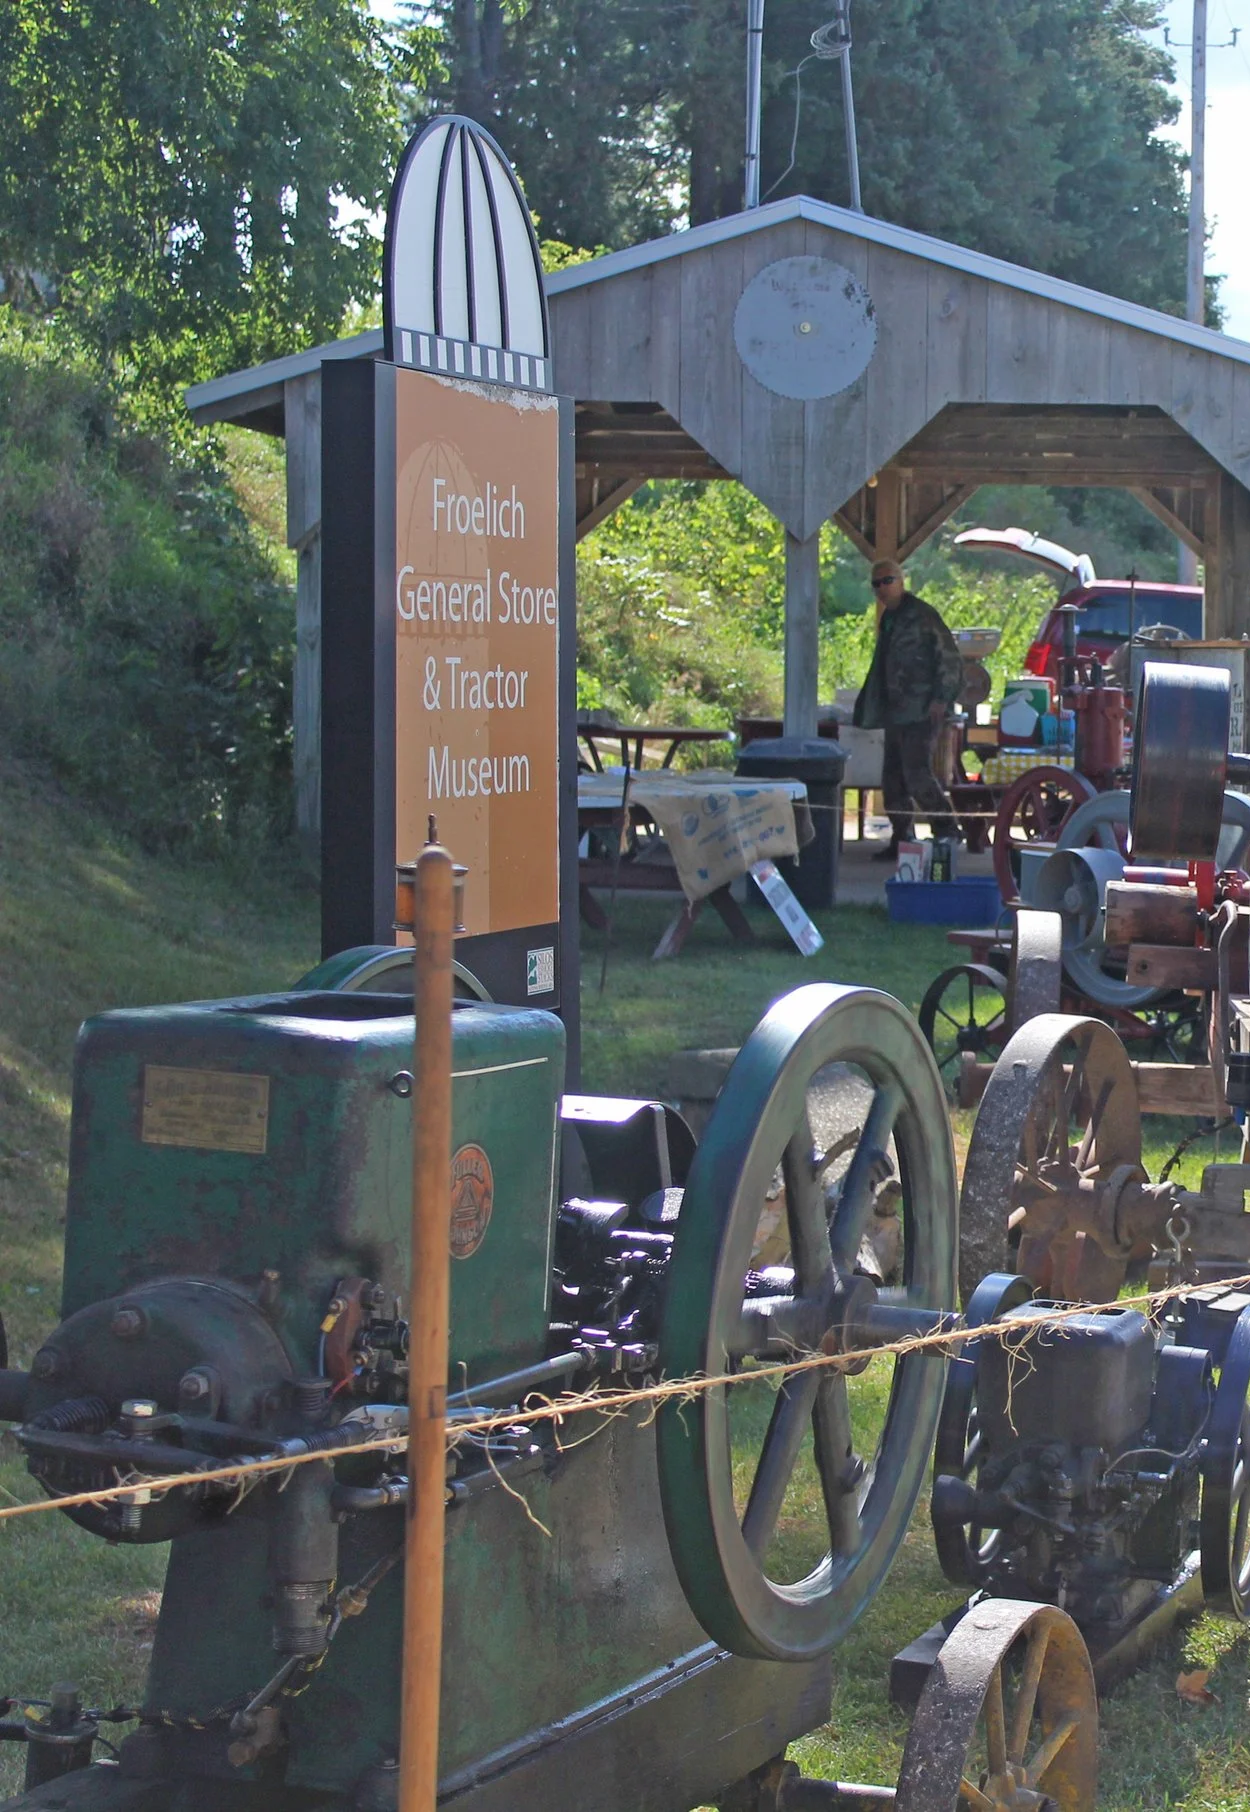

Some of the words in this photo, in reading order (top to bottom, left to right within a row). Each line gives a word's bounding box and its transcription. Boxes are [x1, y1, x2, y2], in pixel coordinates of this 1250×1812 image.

[433, 477, 526, 539] Froelich
[396, 564, 491, 623] General
[498, 570, 556, 625] Store
[423, 655, 441, 711] &
[445, 656, 529, 710] Tractor
[427, 744, 530, 800] Museum
